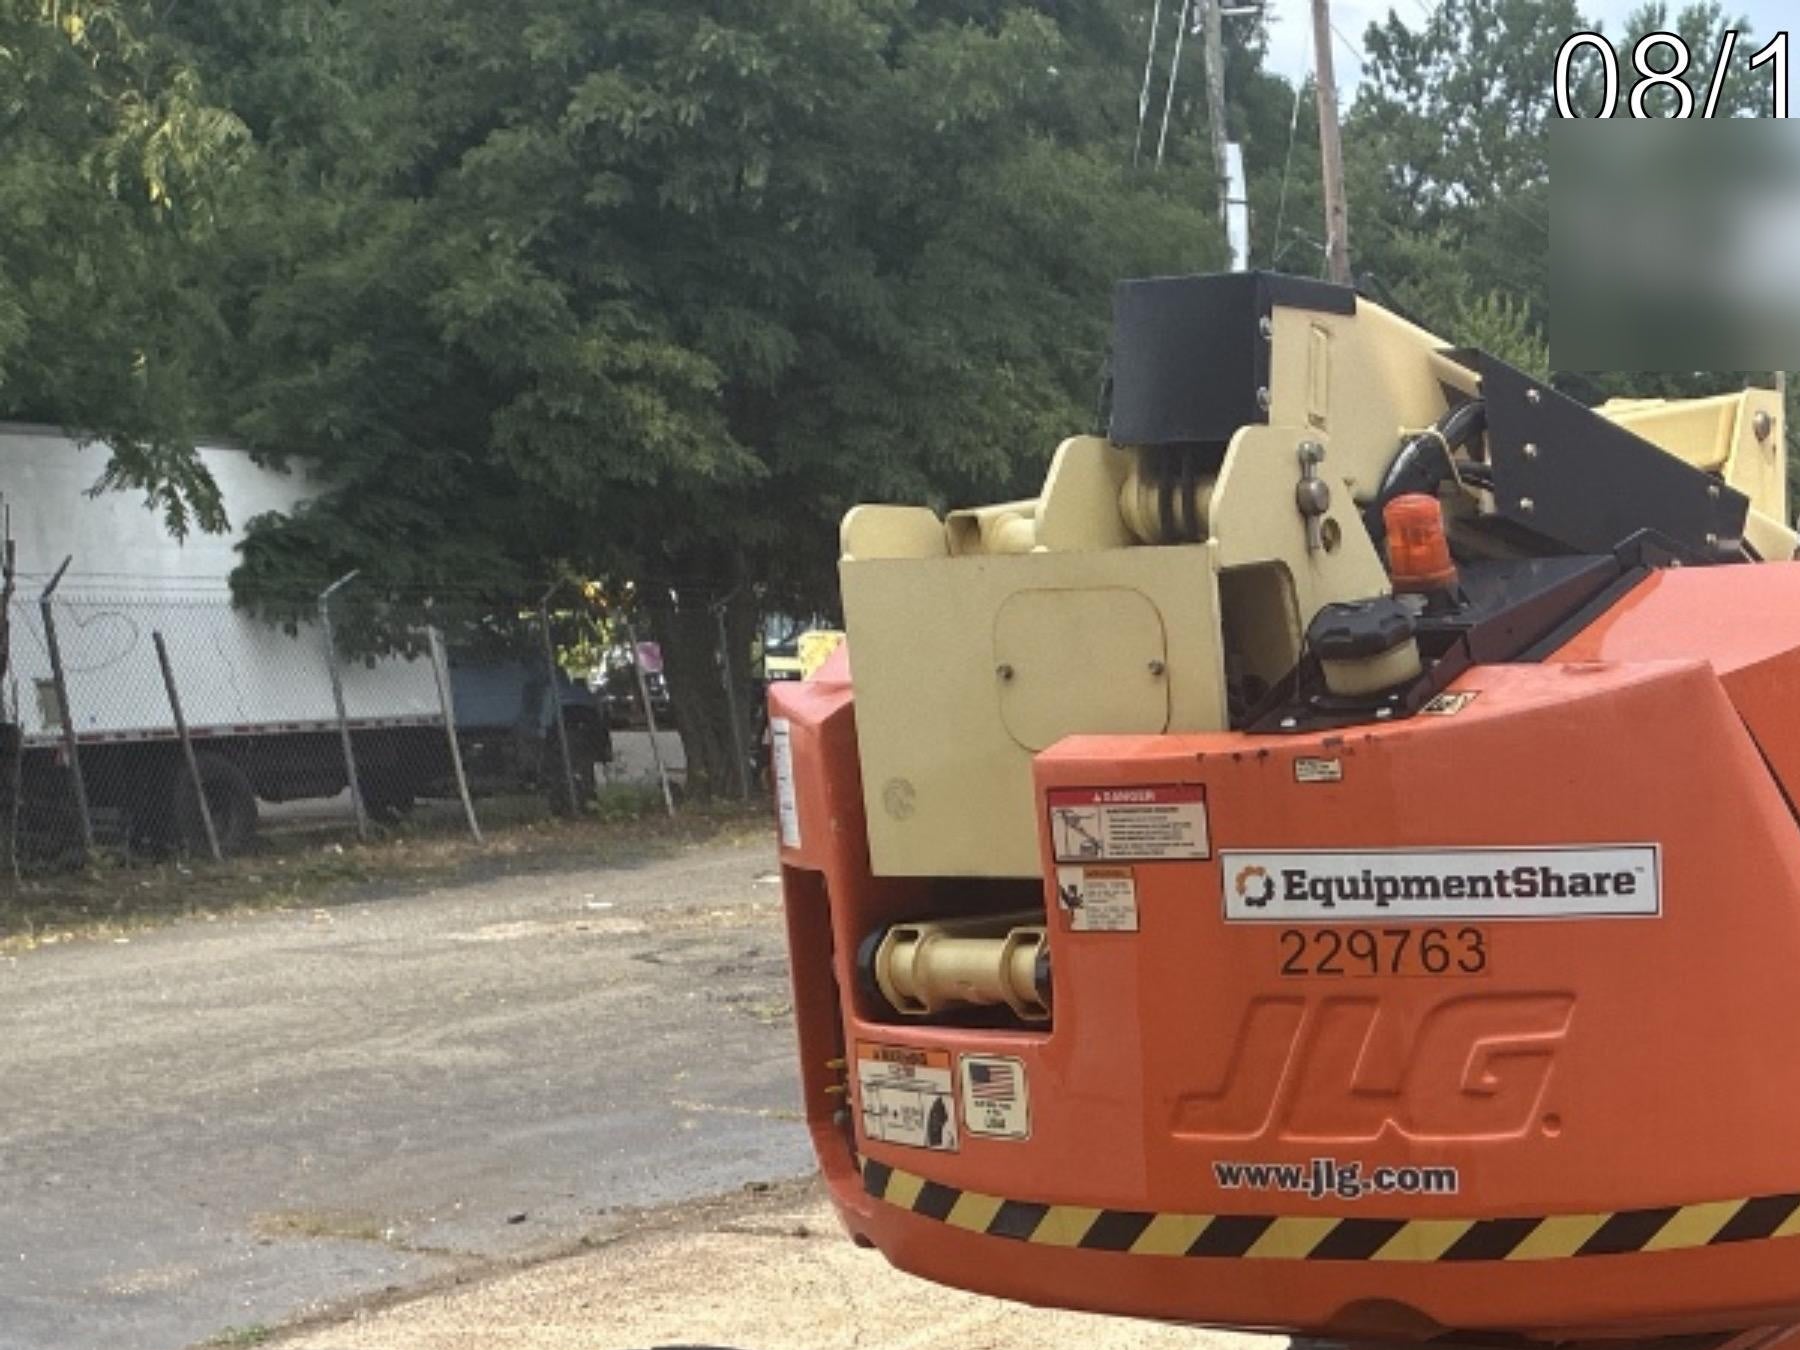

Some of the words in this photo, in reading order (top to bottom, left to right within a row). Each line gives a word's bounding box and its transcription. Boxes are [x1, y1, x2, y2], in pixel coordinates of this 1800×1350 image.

[1281, 866, 1636, 908] EquipmentShare
[1279, 926, 1488, 977] 229763
[1212, 1157, 1459, 1199] www.jlg.com
